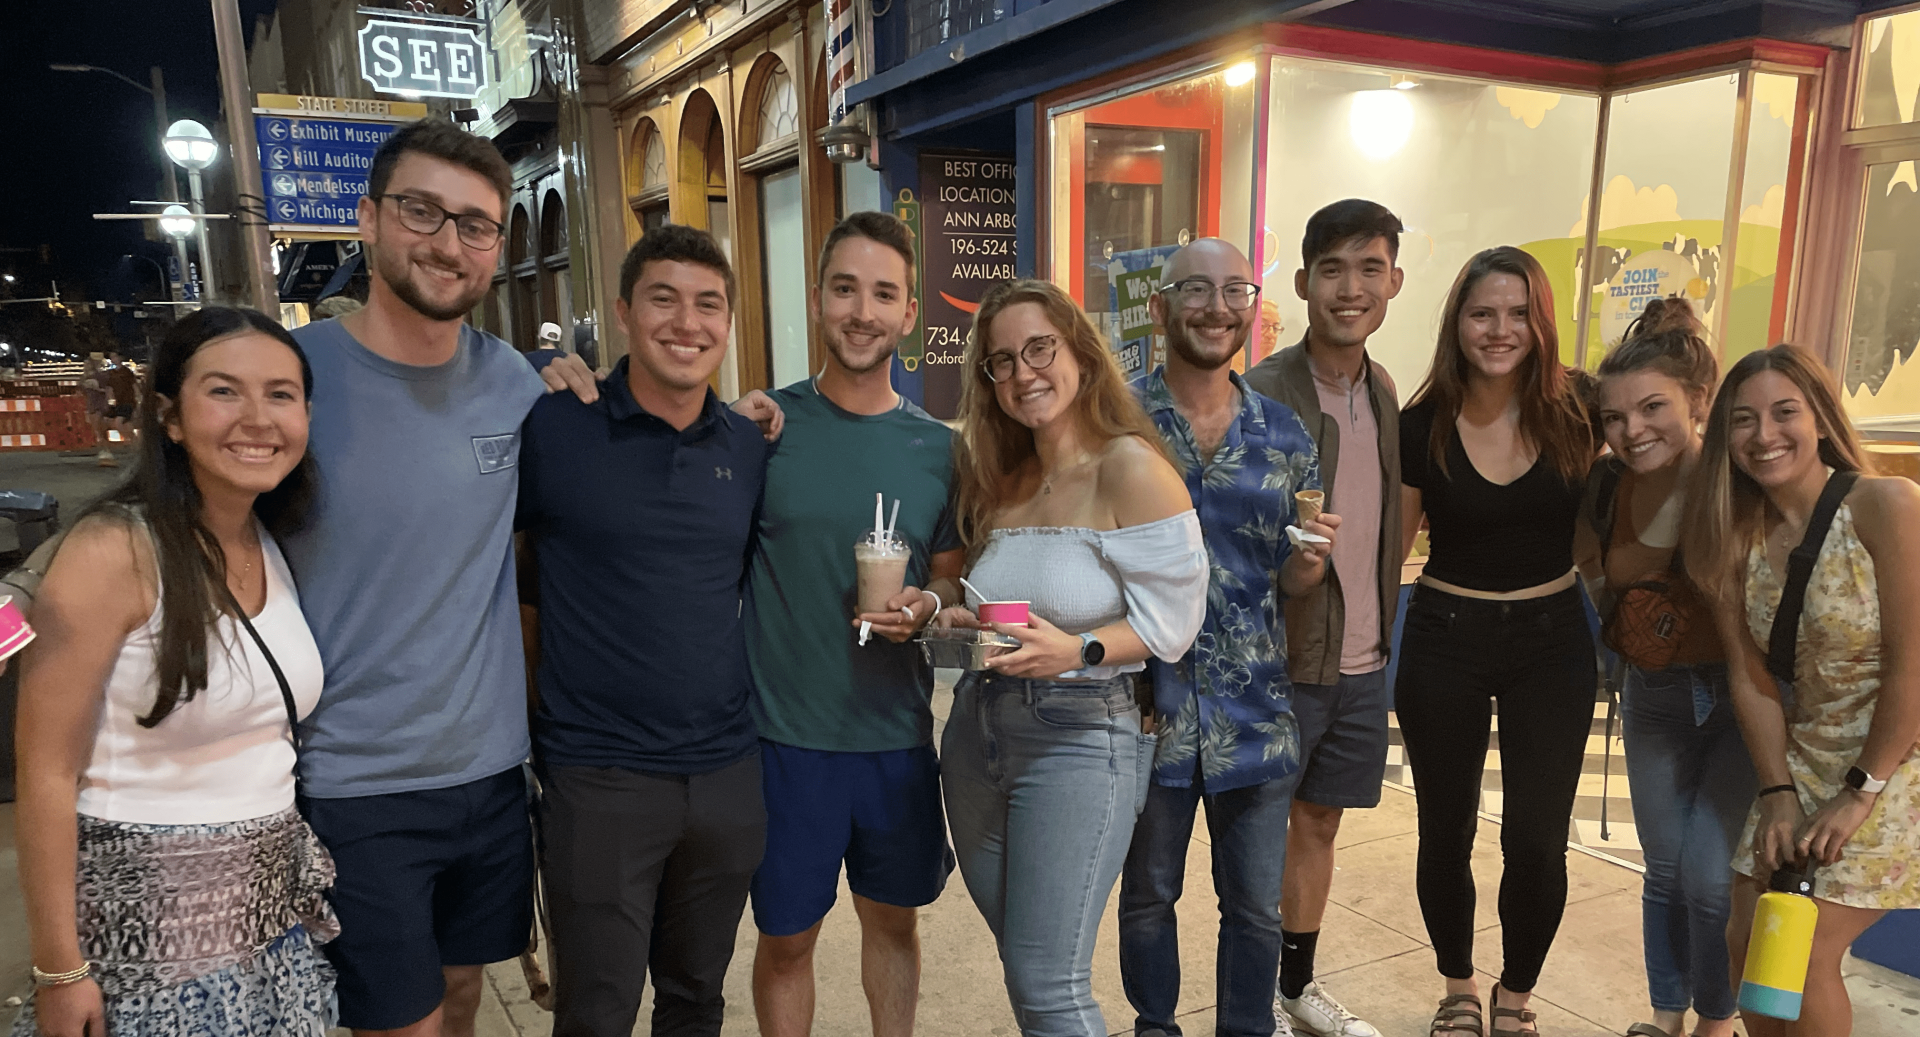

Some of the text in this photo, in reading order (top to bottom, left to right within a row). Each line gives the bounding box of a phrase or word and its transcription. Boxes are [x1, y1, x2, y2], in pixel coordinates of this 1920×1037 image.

[371, 35, 476, 84] SEE
[297, 97, 391, 115] STATE STREET
[290, 124, 340, 142] Exhibit
[293, 151, 319, 167] Hill
[944, 161, 977, 178] BEST
[943, 212, 980, 227] ANN
[950, 238, 1008, 256] 196-524
[1623, 268, 1658, 284] JOIN
[1610, 283, 1659, 297] TASTIEST
[1121, 304, 1153, 330] HIR
[925, 350, 965, 365] Oxford
